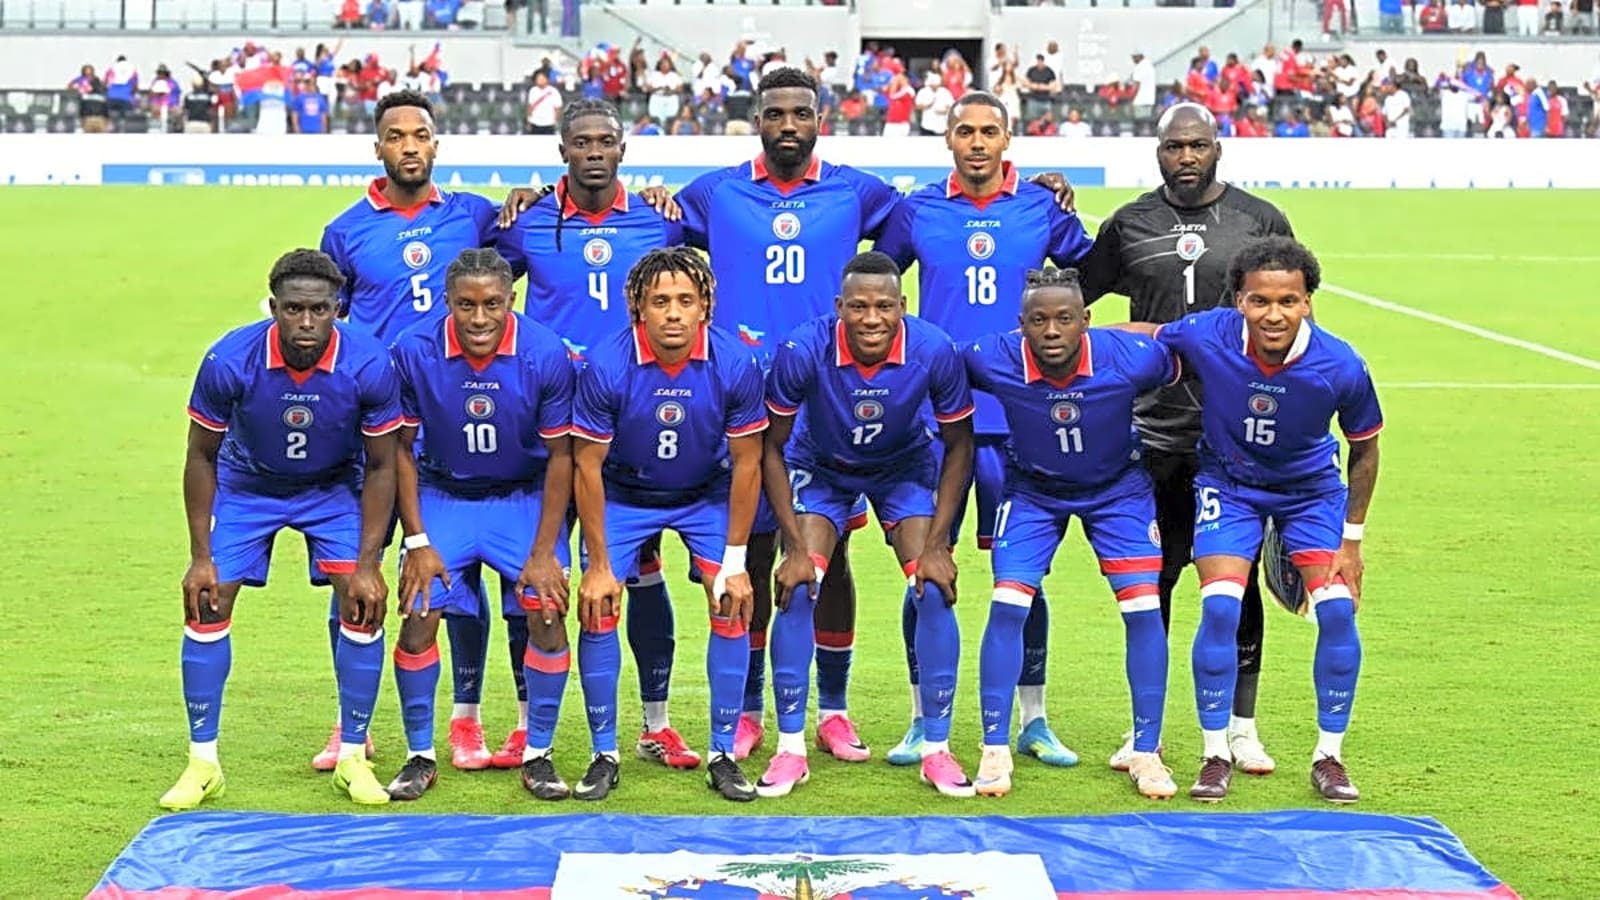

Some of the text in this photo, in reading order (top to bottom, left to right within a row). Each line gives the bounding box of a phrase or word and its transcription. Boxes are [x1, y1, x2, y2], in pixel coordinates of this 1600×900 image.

[579, 227, 618, 236] SAETA
[1170, 224, 1207, 232] SAETA
[765, 244, 805, 284] 20
[410, 272, 433, 312] 5
[588, 271, 609, 311] 4
[964, 265, 997, 305] 18
[1182, 264, 1195, 305] 1
[280, 393, 320, 402] SAETA
[461, 381, 500, 390] SAETA
[653, 388, 692, 397] SAETA
[851, 388, 889, 397] SAETA
[286, 431, 307, 459] 2
[462, 423, 497, 453] 10
[657, 430, 678, 459] 8
[851, 423, 883, 445] 17
[1055, 427, 1083, 453] 11
[1243, 417, 1276, 446] 15
